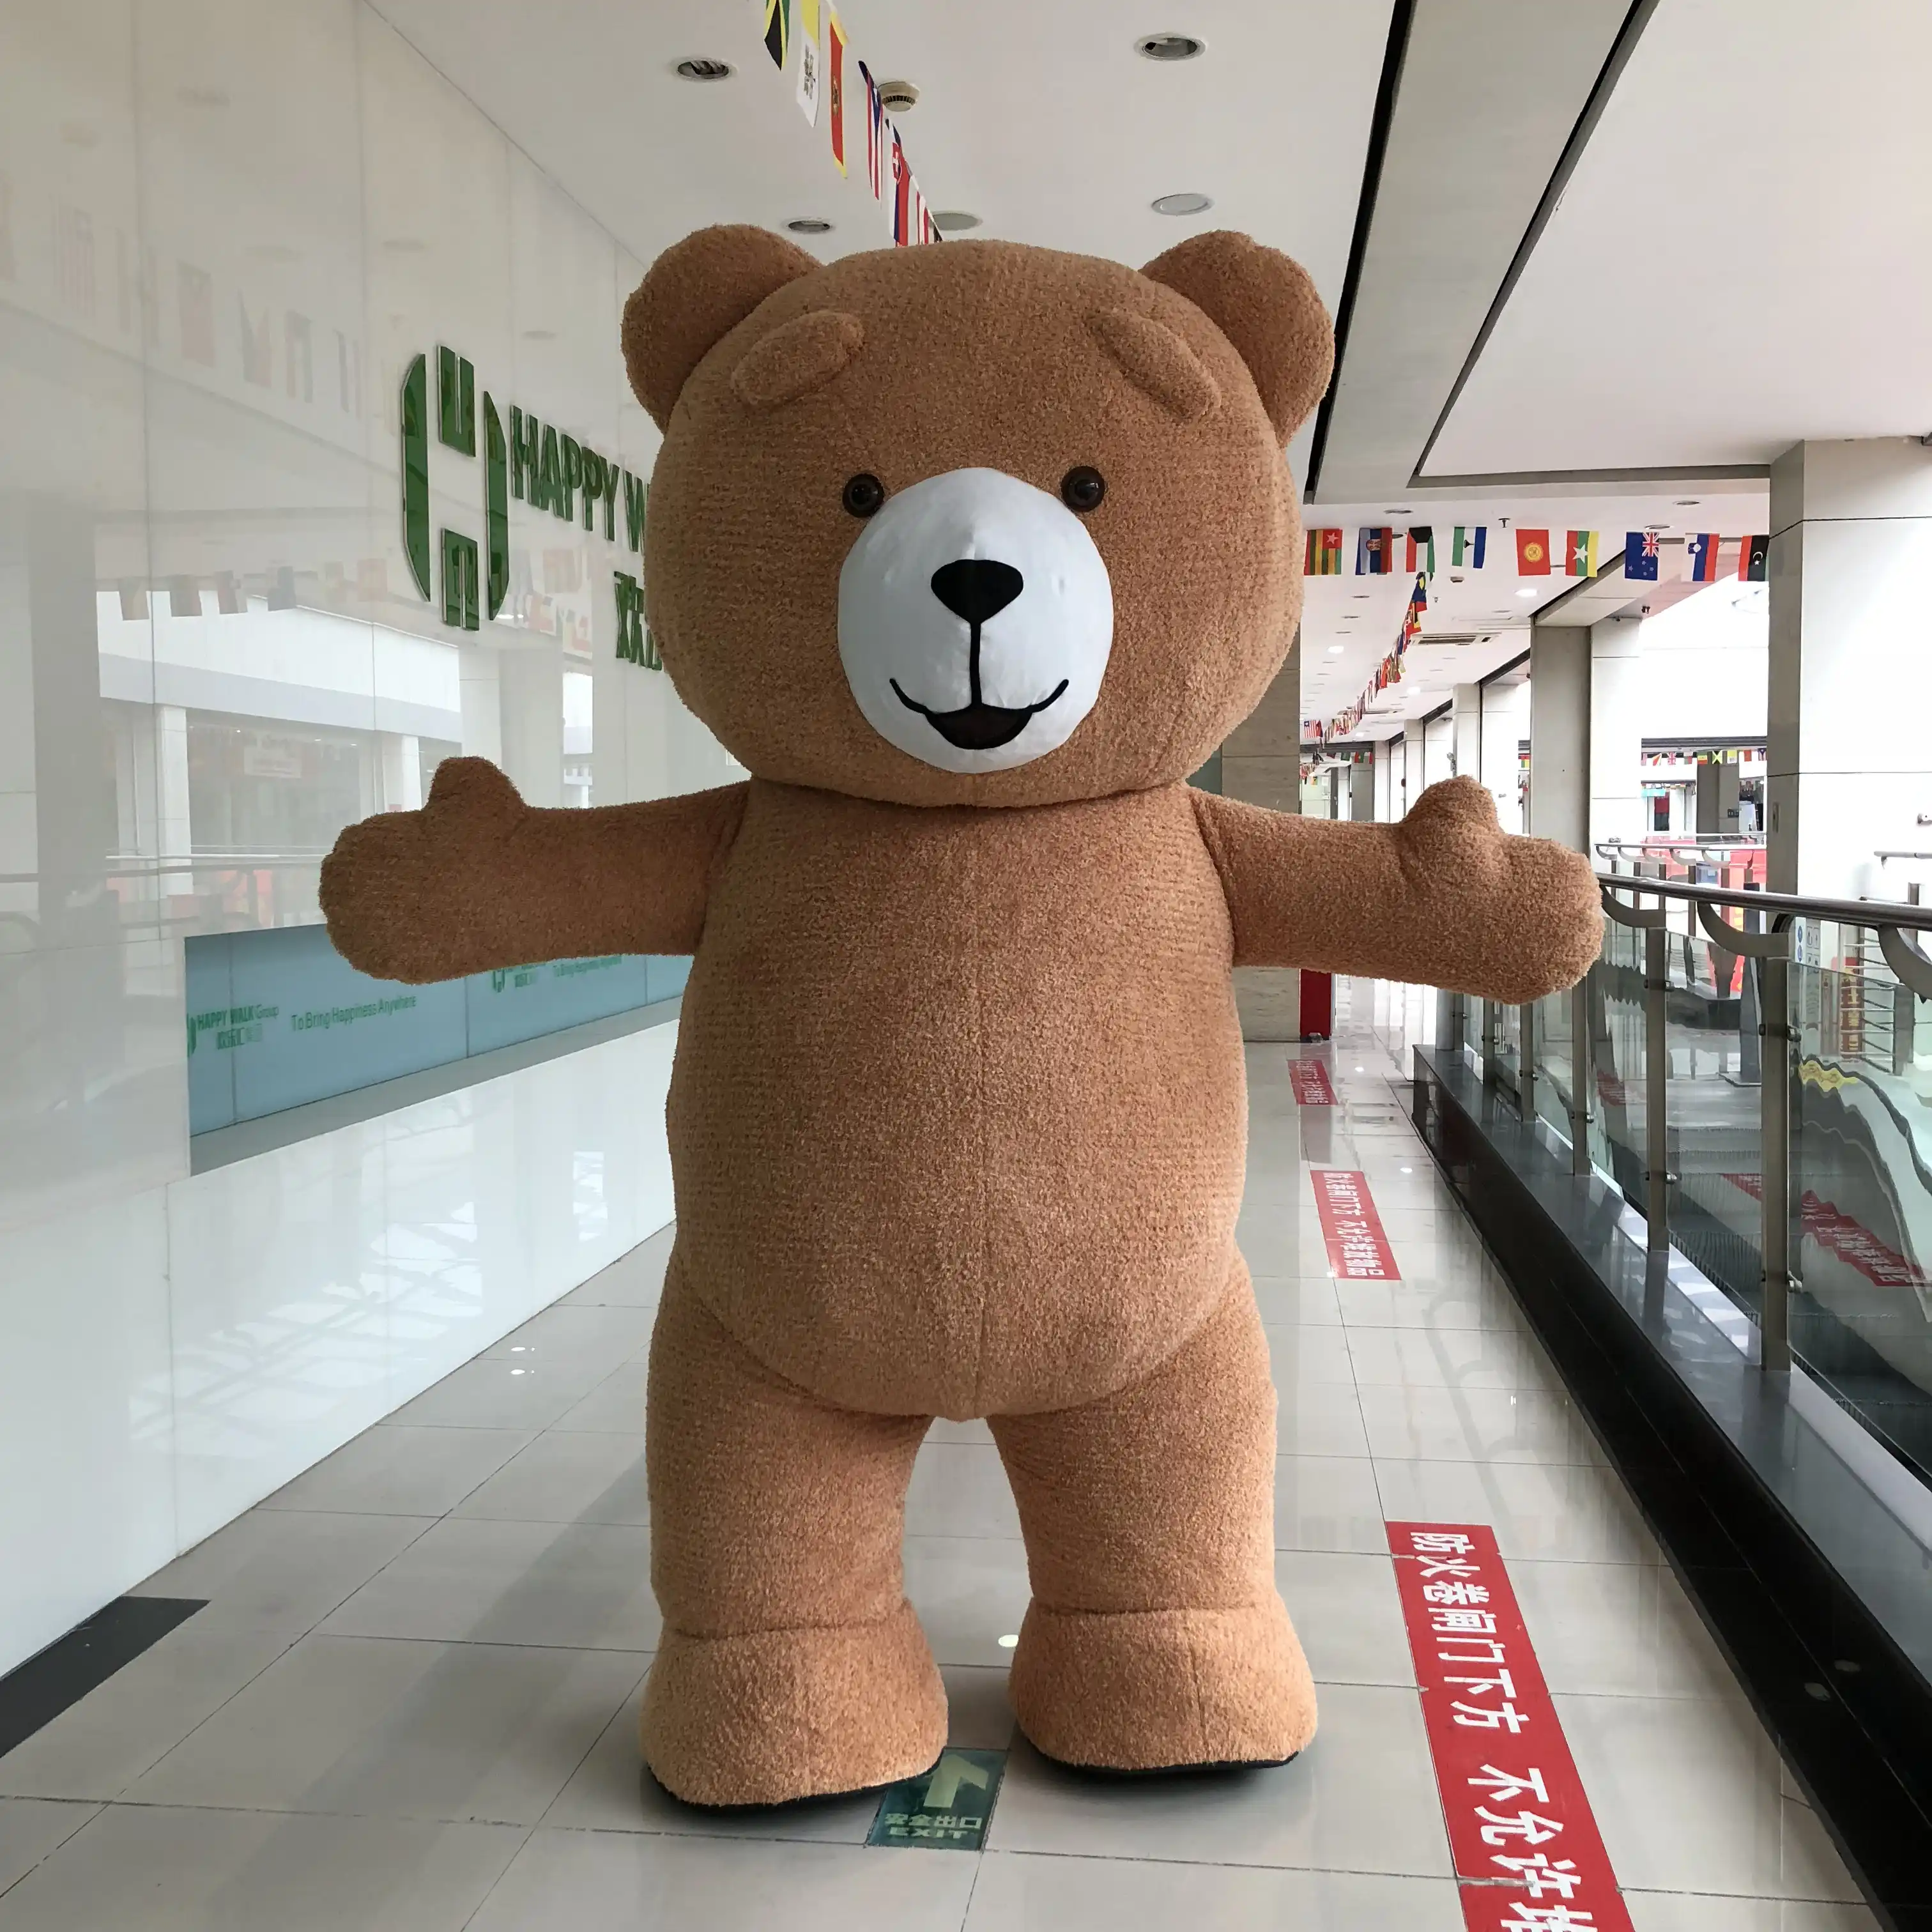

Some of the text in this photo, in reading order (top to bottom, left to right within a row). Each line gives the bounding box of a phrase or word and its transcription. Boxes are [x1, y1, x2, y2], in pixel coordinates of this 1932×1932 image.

[510, 406, 619, 541] HAPPY
[197, 1009, 227, 1031] HAPPY
[291, 995, 417, 1031] To Bring Happiness Anywhere
[1410, 1531, 1530, 1734] 防火卷闸门下方
[884, 1813, 983, 1829] 安全出口
[888, 1827, 969, 1839] EXIT
